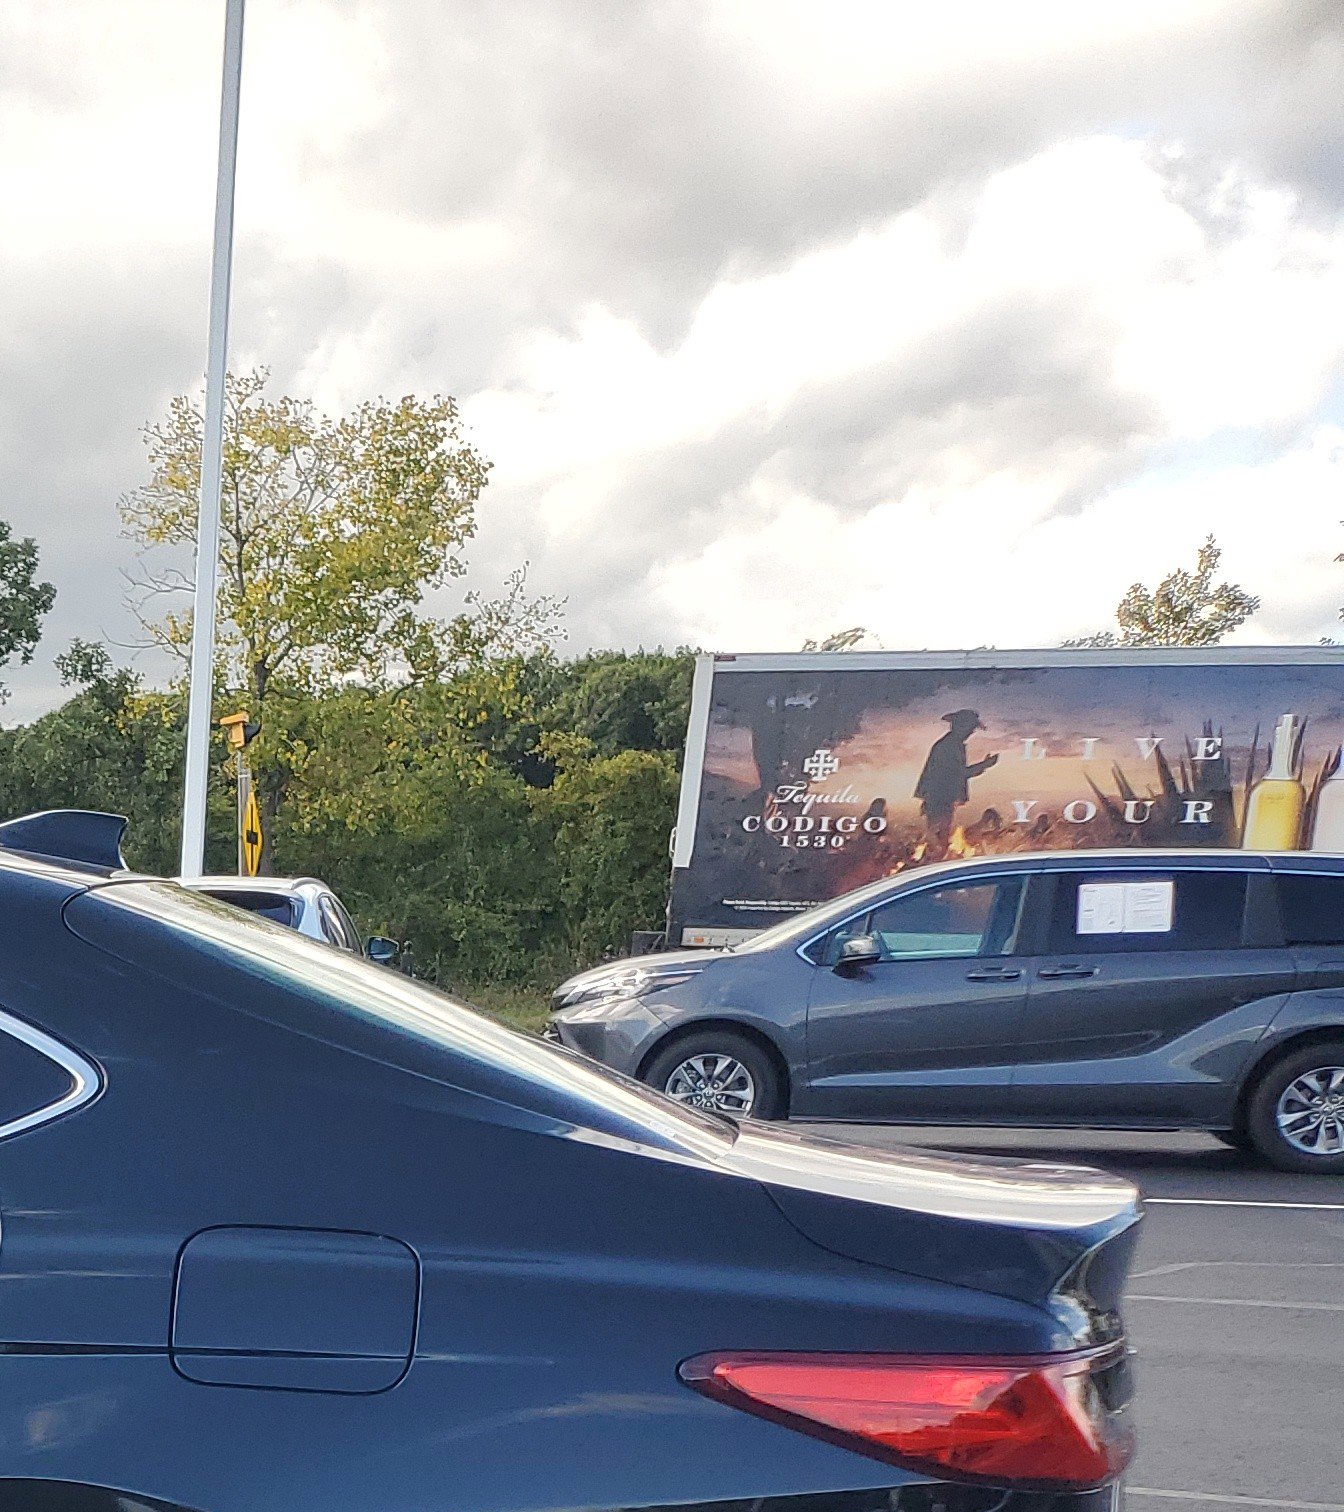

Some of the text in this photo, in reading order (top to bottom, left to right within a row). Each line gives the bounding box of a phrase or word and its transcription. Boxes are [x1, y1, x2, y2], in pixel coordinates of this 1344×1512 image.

[1020, 737, 1222, 760] LIVE
[773, 781, 859, 815] Tequila
[742, 811, 887, 833] CÓDIGO
[1013, 800, 1212, 823] YOUR
[780, 835, 844, 847] 1530
